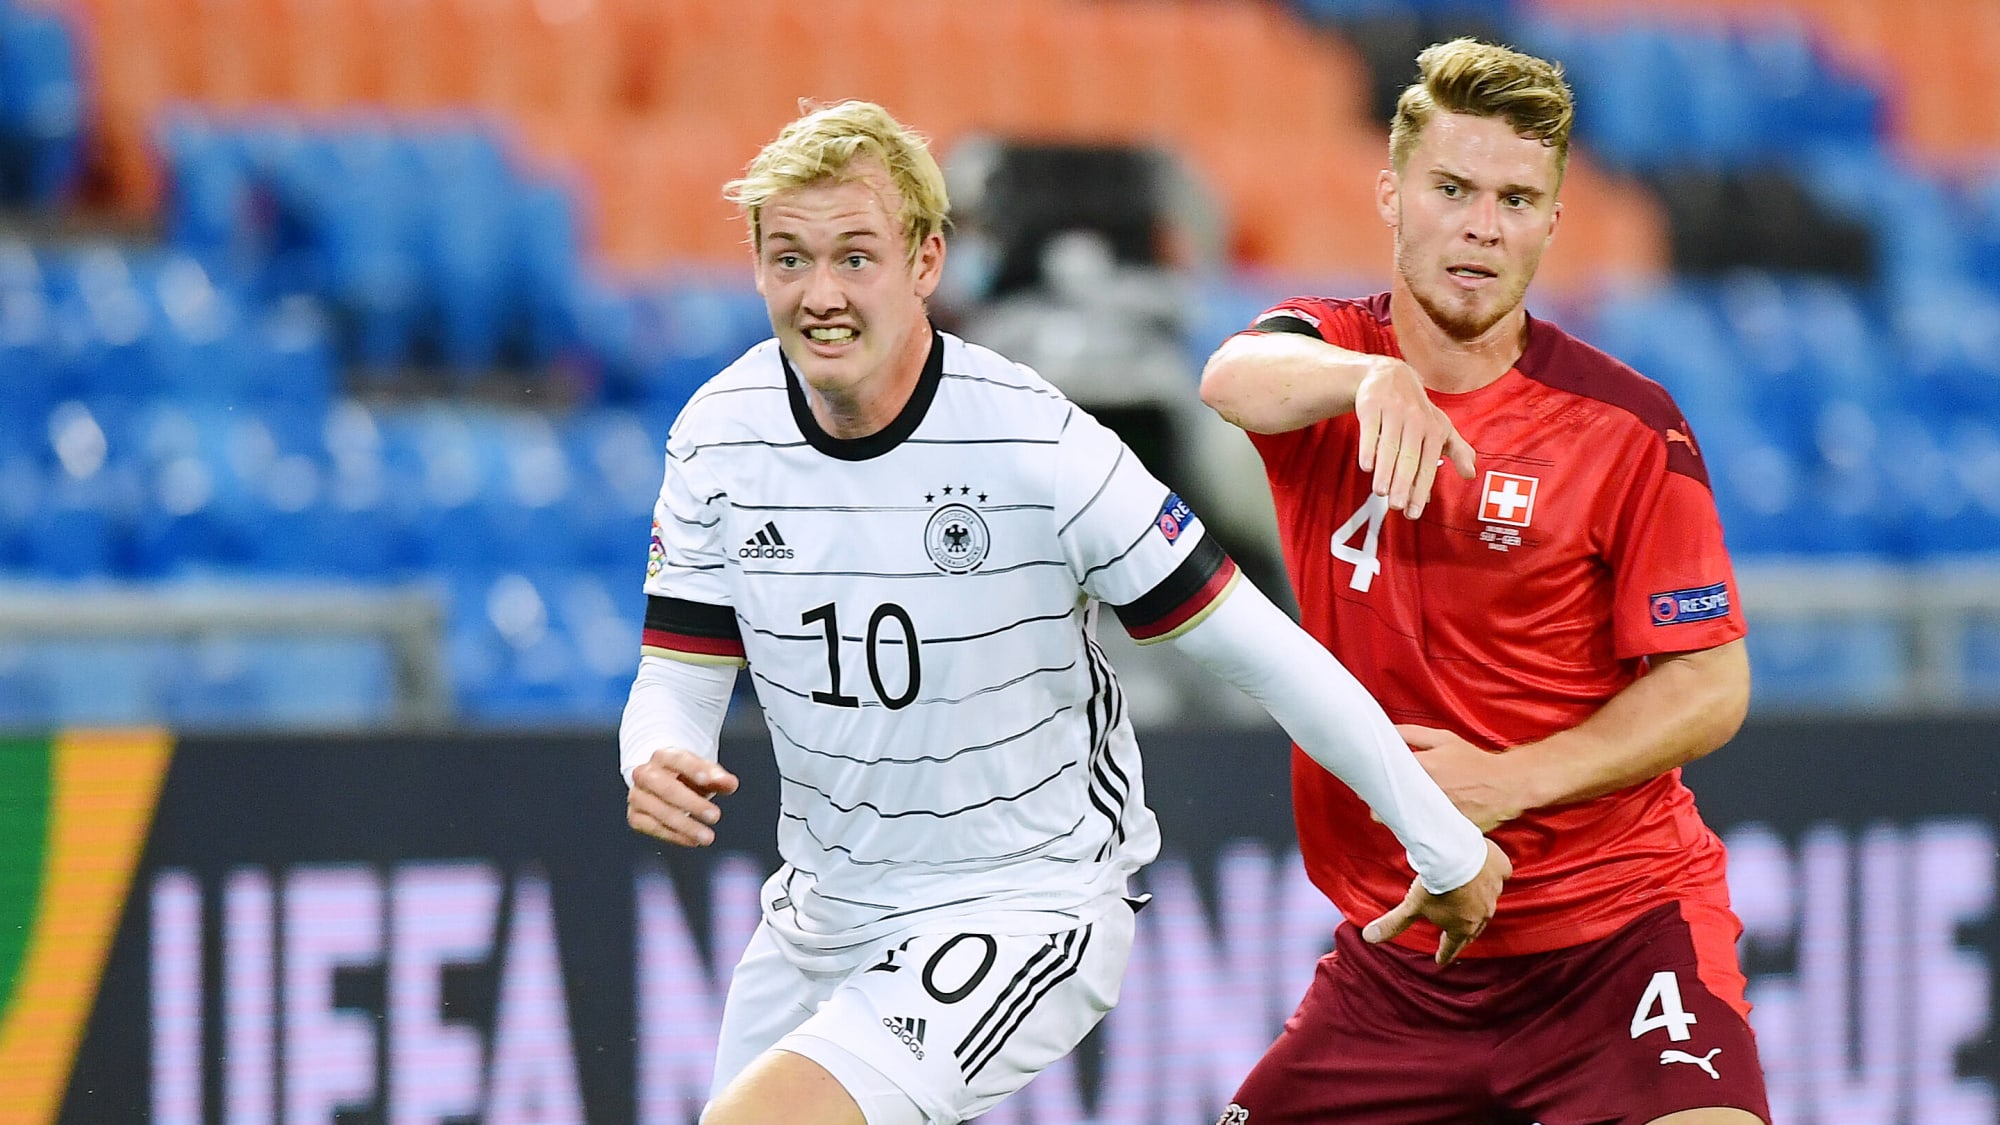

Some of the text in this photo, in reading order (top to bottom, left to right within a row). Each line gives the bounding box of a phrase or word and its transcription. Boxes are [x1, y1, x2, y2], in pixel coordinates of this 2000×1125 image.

[738, 545, 795, 559] adidas
[1331, 490, 1390, 592] 4
[800, 600, 922, 711] 10
[882, 1017, 925, 1061] adidas
[1630, 970, 1698, 1042] 4
